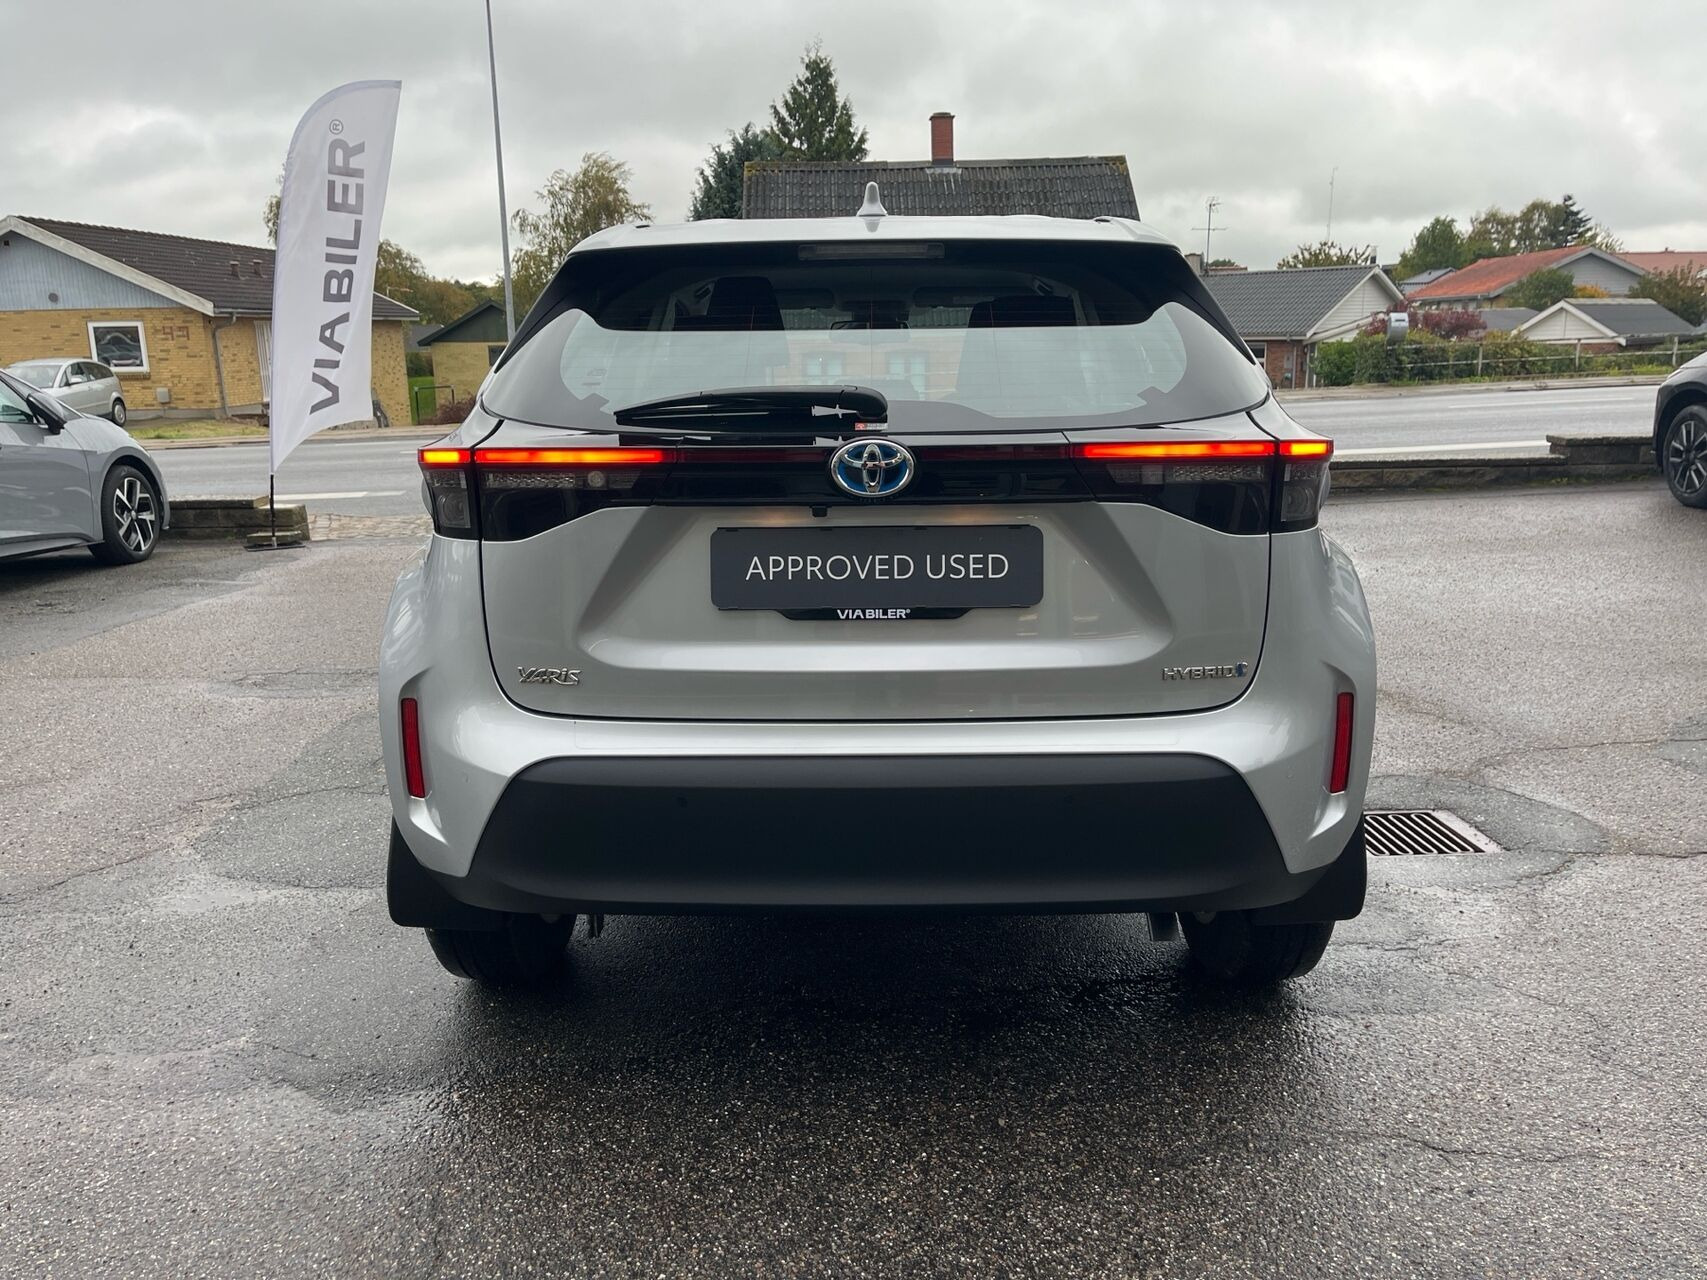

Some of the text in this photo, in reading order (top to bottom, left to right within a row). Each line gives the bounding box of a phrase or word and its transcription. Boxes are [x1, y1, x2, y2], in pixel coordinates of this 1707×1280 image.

[745, 554, 1009, 580] APPROVED USED
[1162, 665, 1235, 680] HYBRID
